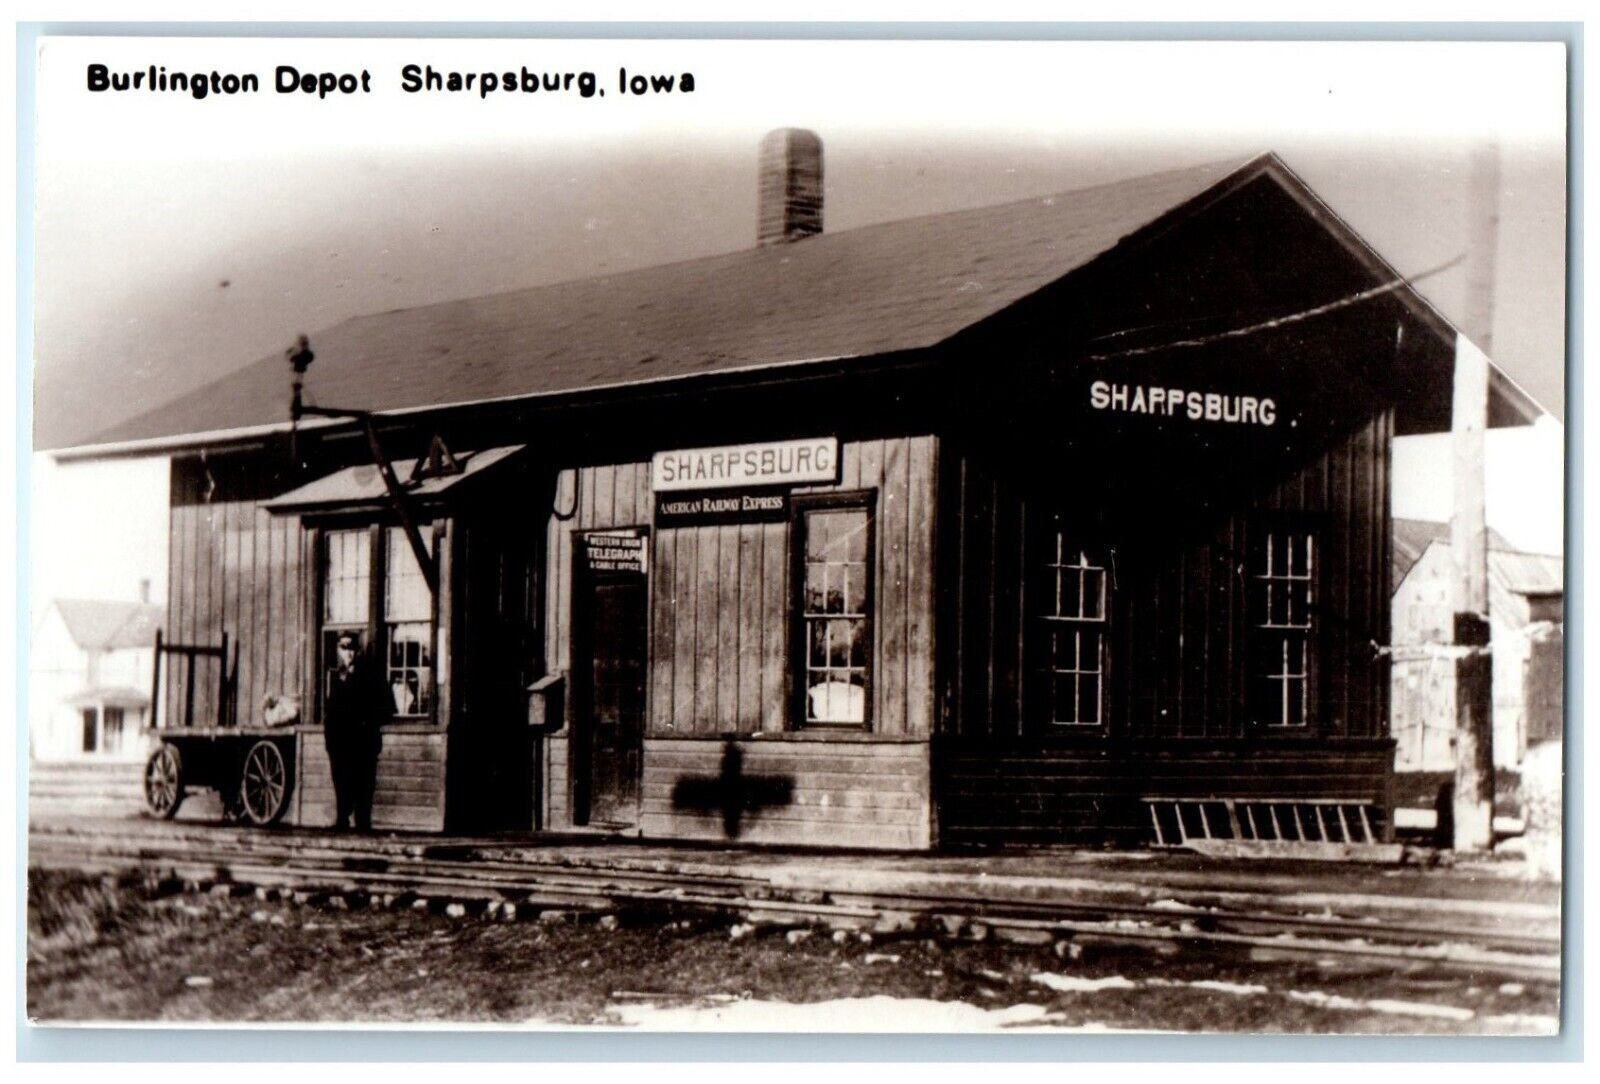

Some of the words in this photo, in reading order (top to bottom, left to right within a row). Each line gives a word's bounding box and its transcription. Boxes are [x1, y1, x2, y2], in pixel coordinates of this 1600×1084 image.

[1090, 380, 1277, 427] SHARPSBURG
[660, 501, 701, 516] AMERICAN
[702, 497, 739, 513] RAILWAY
[742, 495, 784, 510] EXPRESS
[587, 547, 642, 560] TELEGRAPH
